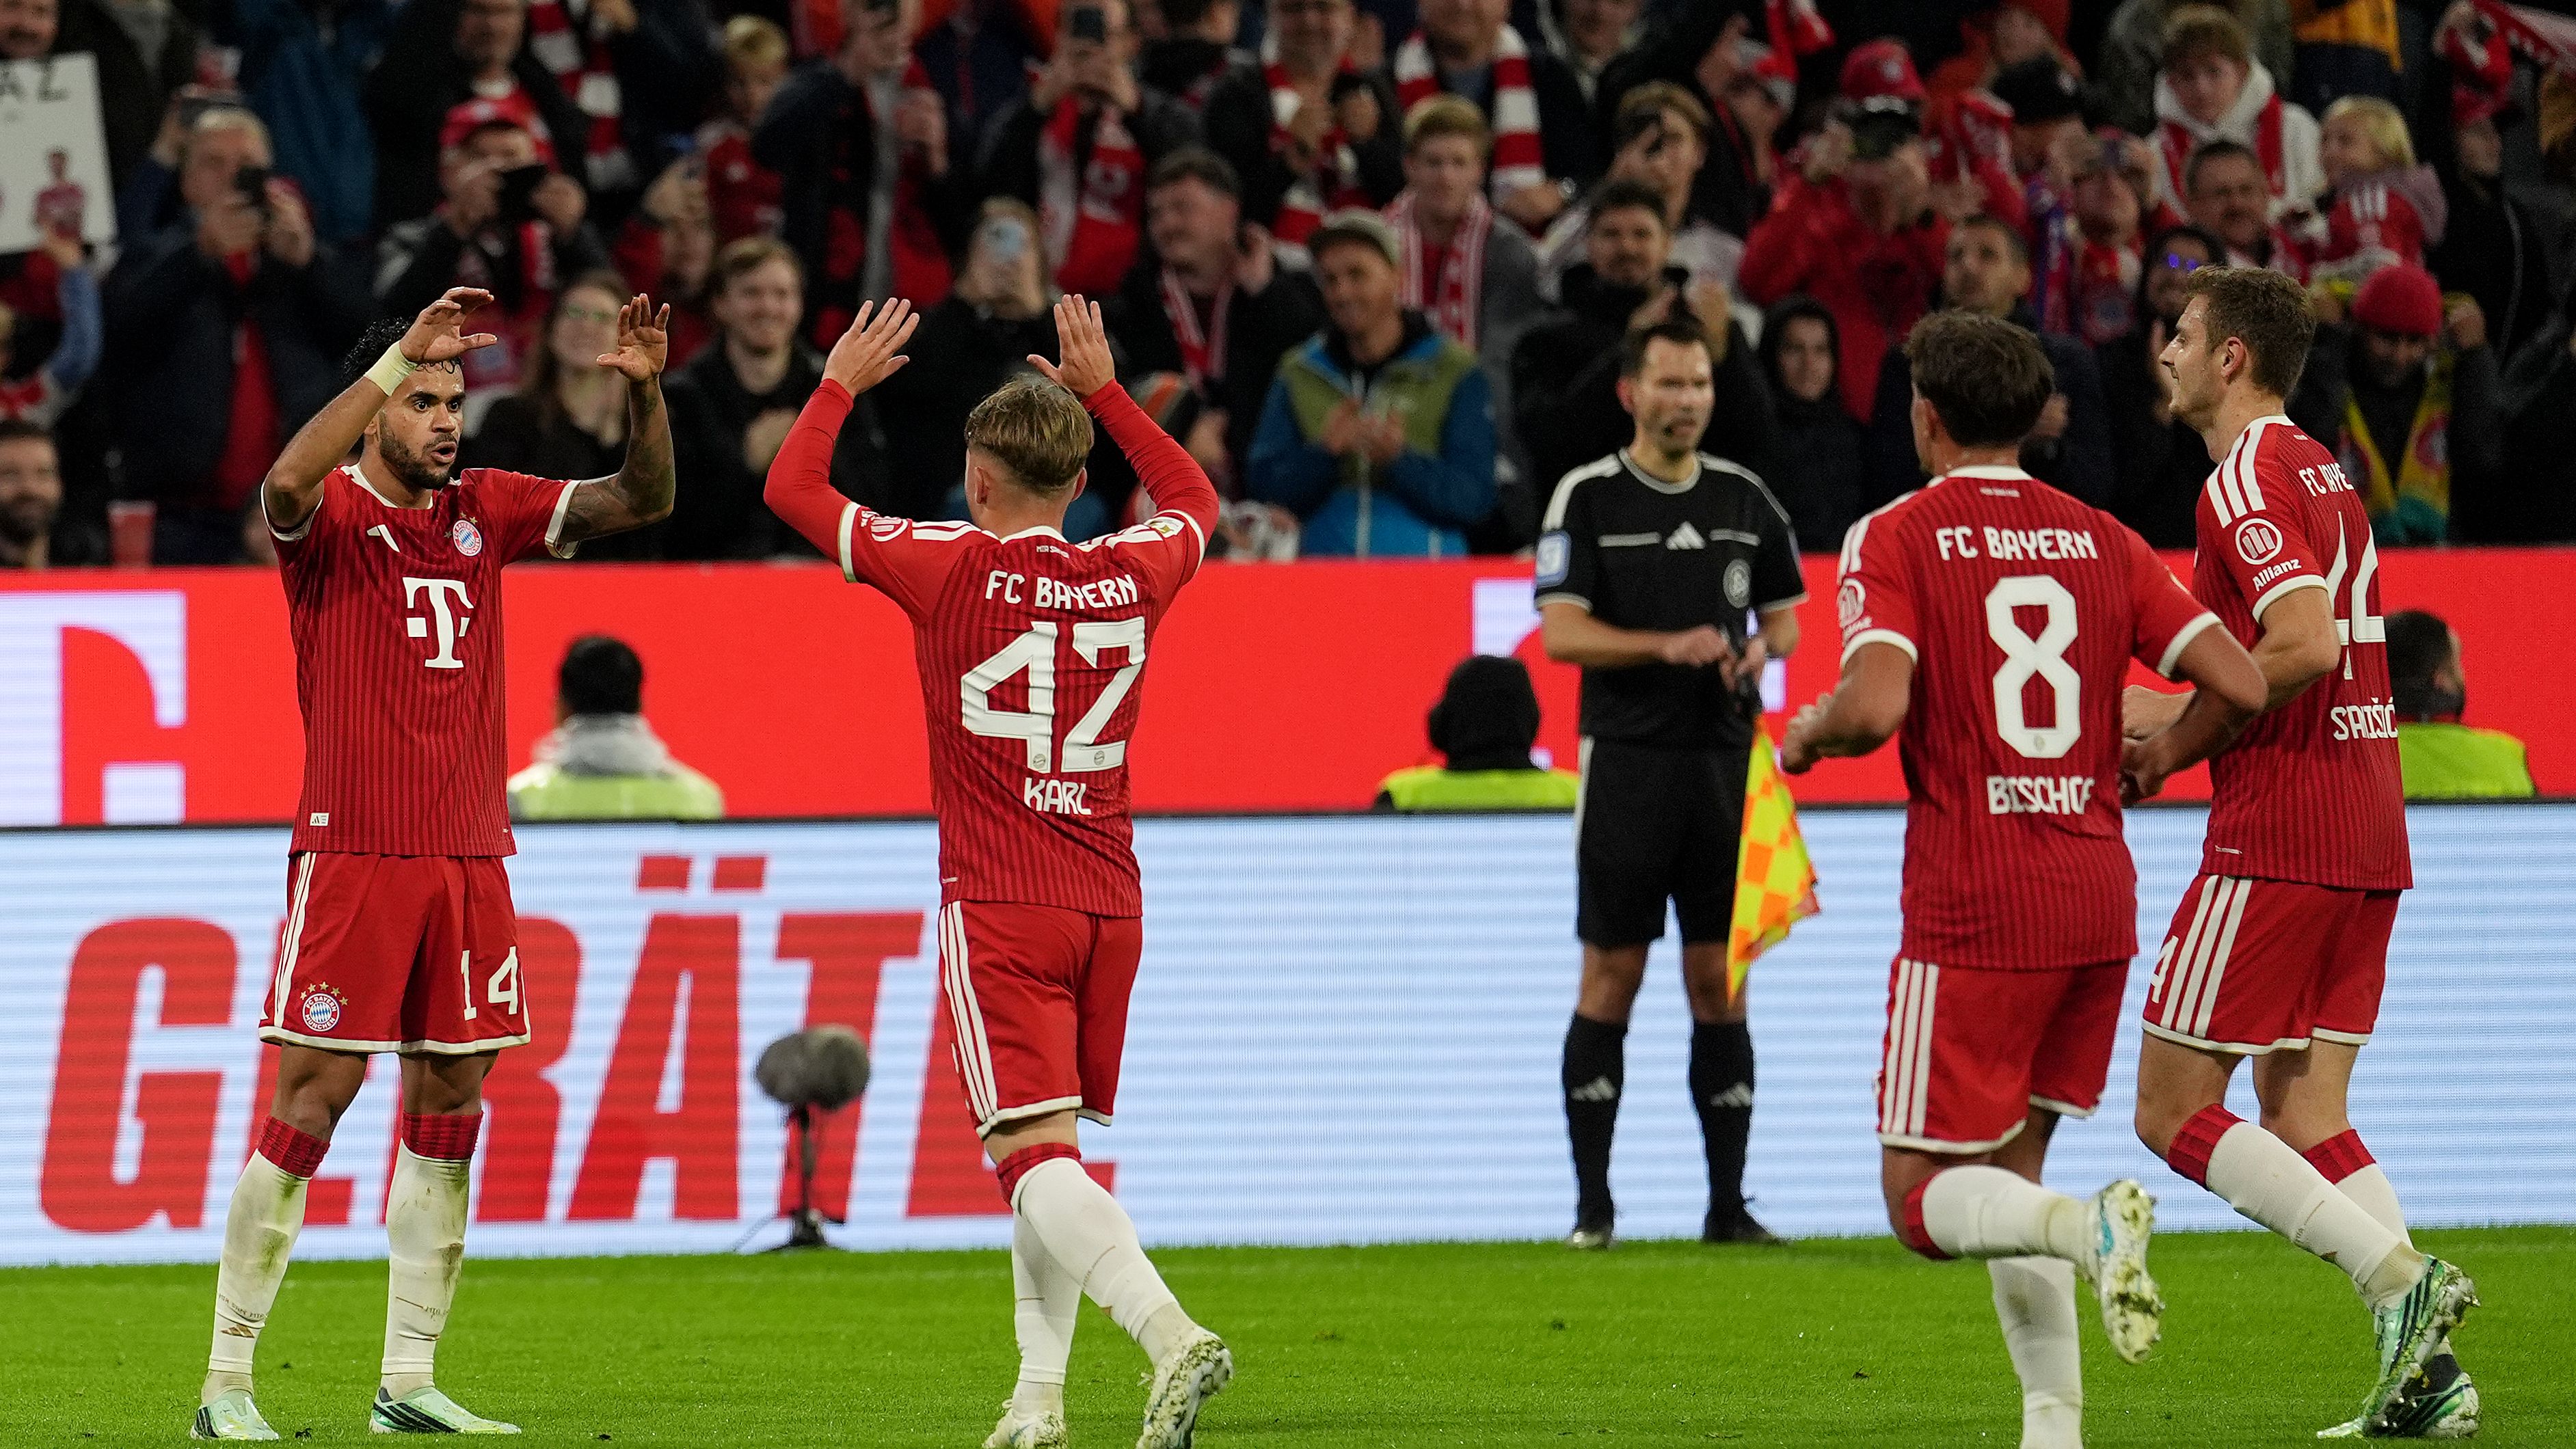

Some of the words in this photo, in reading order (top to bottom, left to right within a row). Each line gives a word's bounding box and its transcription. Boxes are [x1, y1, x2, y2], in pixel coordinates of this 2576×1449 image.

[2298, 468, 2327, 497] FC
[1935, 526, 1978, 560] FC
[1983, 526, 2098, 560] BAYERN
[985, 570, 1025, 604] FC
[1034, 573, 1138, 610] BAYERN
[2253, 559, 2302, 592] Allianz
[1985, 575, 2081, 758] 8
[961, 617, 1146, 774] 42
[1024, 777, 1092, 815] KARL
[461, 946, 518, 1020] 14
[314, 996, 337, 1012] BAYERN
